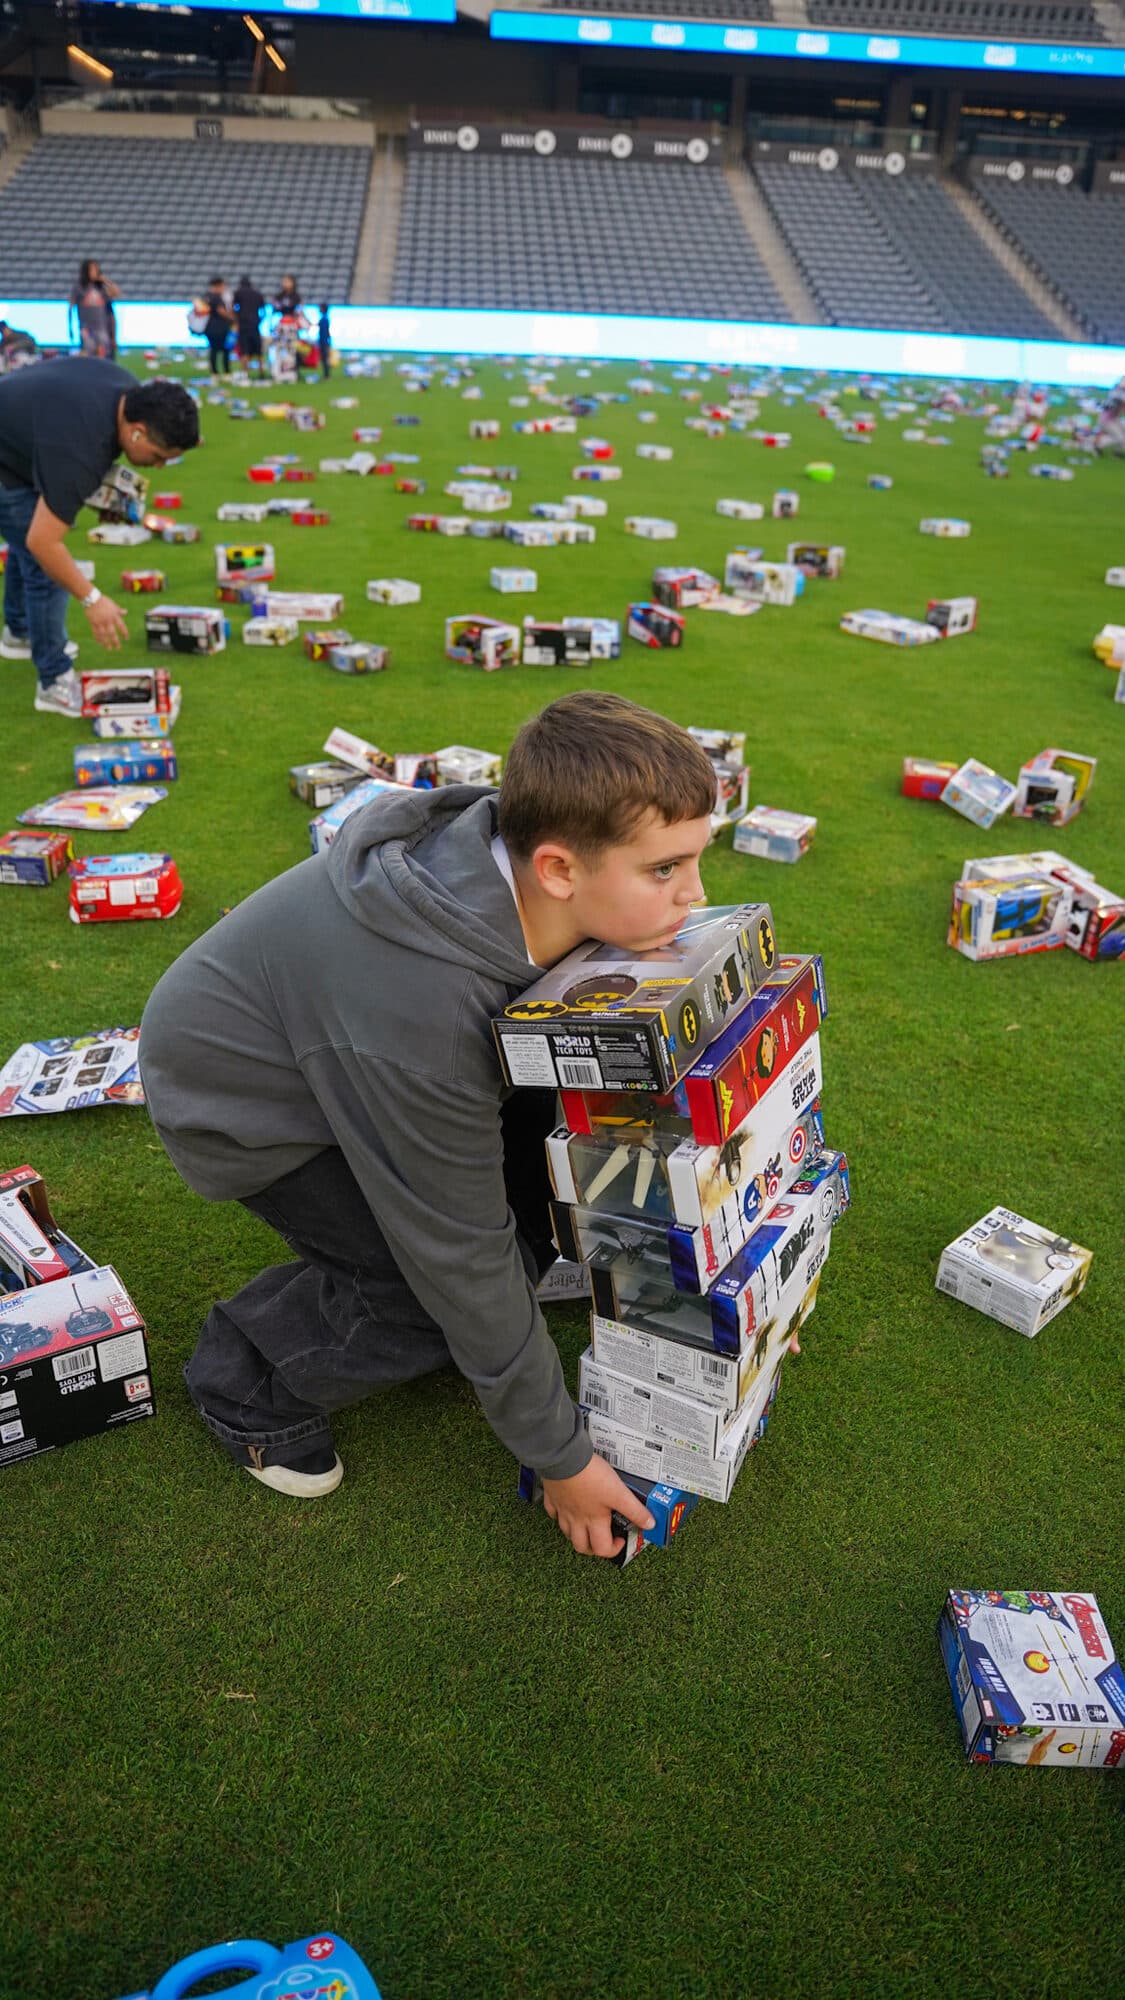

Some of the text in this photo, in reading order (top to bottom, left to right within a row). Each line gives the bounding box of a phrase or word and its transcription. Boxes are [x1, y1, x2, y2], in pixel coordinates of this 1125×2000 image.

[553, 1035, 591, 1047] WORLD
[555, 1047, 593, 1055] TECH TOYS
[792, 1068, 816, 1100] WARS
[792, 1079, 816, 1110] STAR
[58, 1371, 96, 1386] TECH TOYS
[60, 1377, 97, 1395] WORLD
[309, 1942, 333, 1957] 3+
